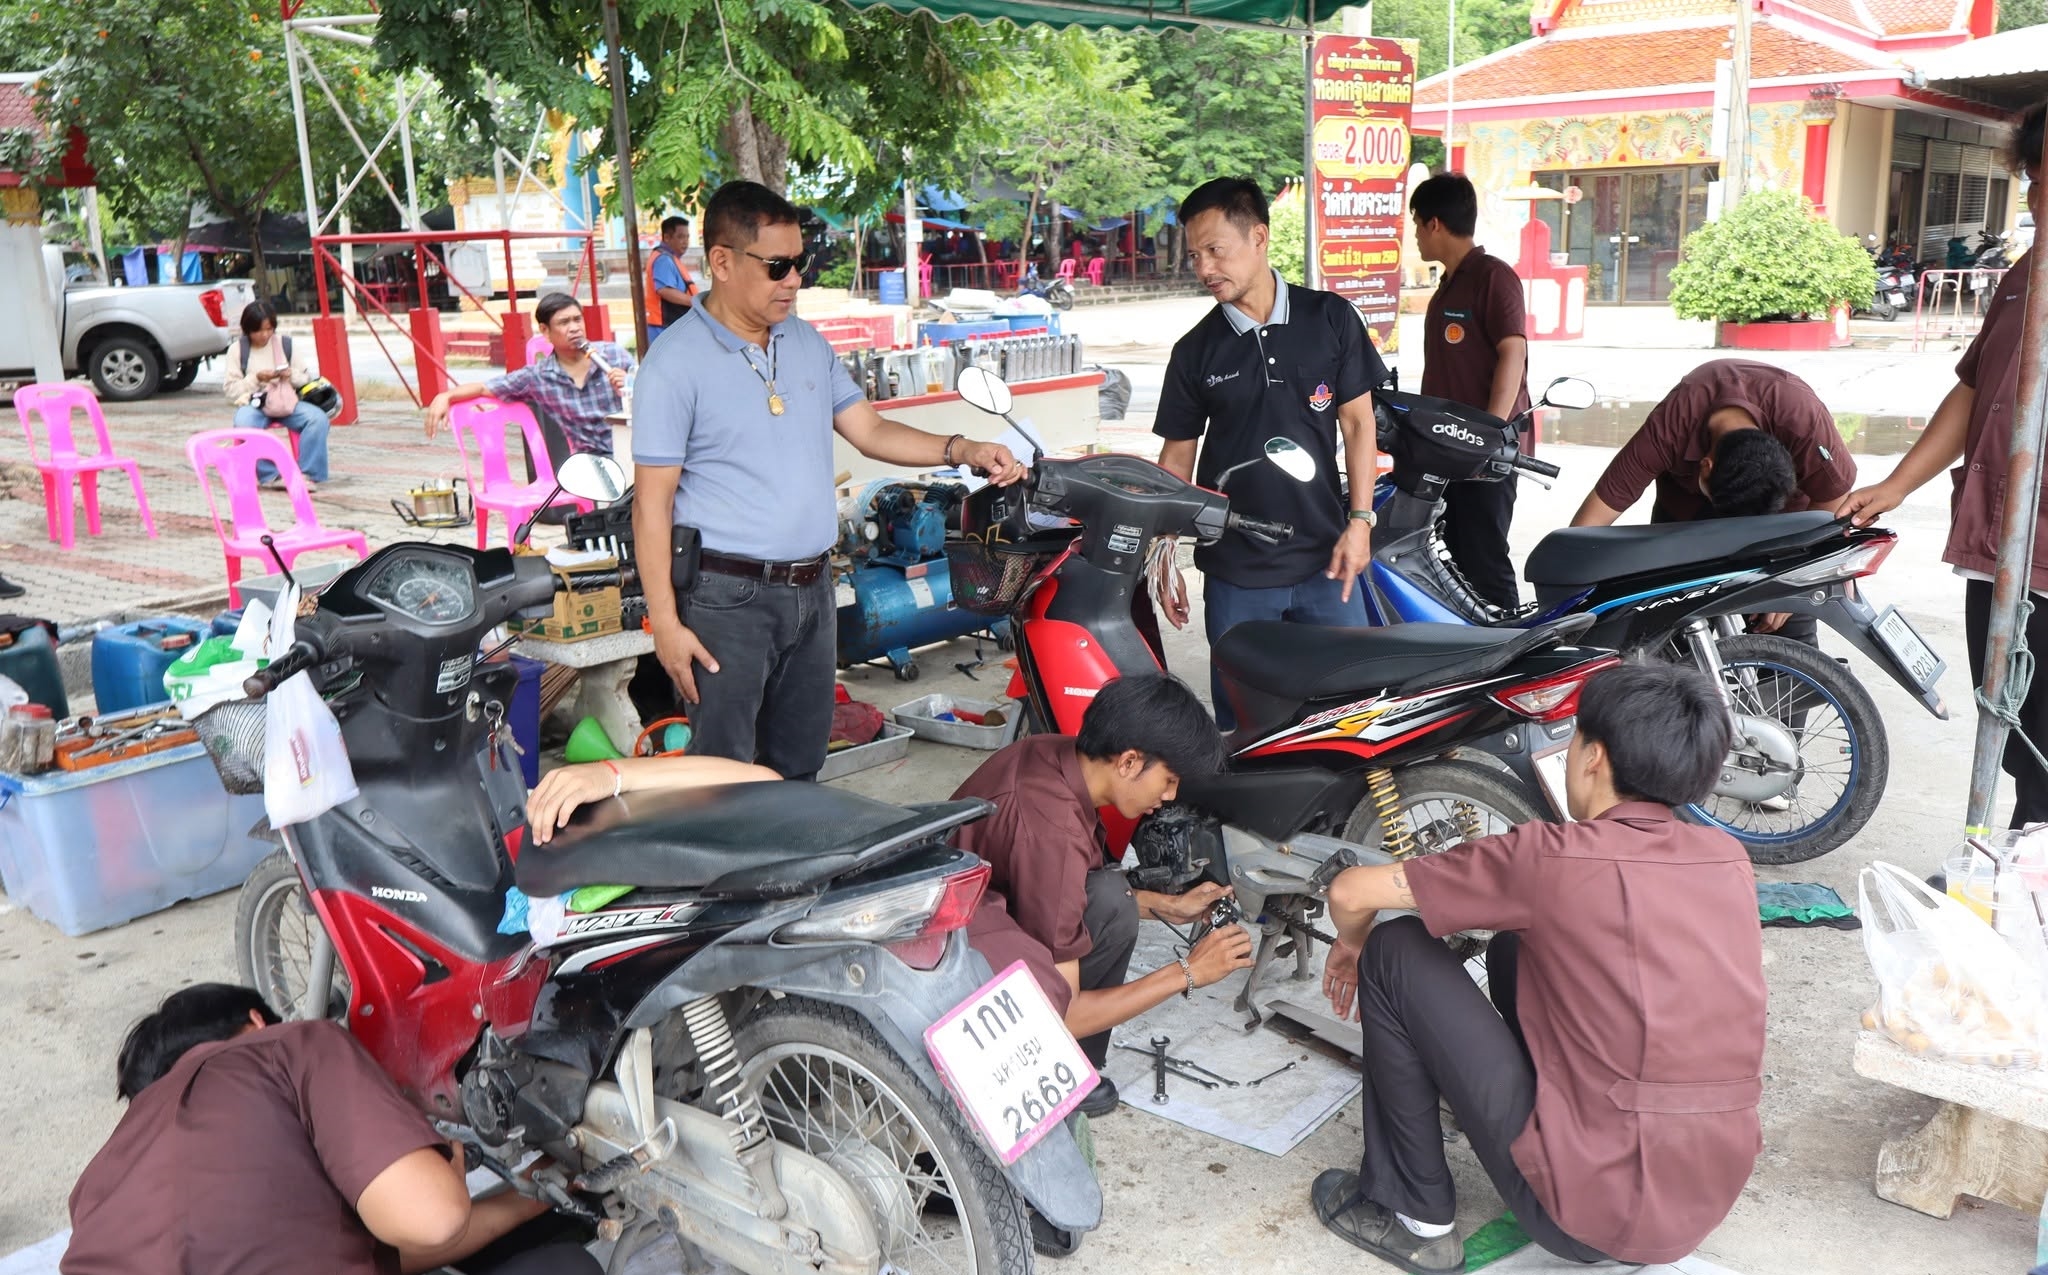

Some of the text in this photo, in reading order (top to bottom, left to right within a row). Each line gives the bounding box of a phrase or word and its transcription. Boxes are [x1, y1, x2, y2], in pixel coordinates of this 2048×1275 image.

[1313, 73, 1412, 107] ทอดกฐินสามัคคี
[1321, 181, 1404, 216] วัดห้วยจระเข้
[1432, 424, 1485, 446] adidas
[1911, 652, 1937, 682] 9231
[1551, 723, 1571, 735] HONDA
[371, 886, 428, 902] HONDA
[962, 989, 1025, 1050] 1กท
[1002, 1061, 1078, 1143] 2669
